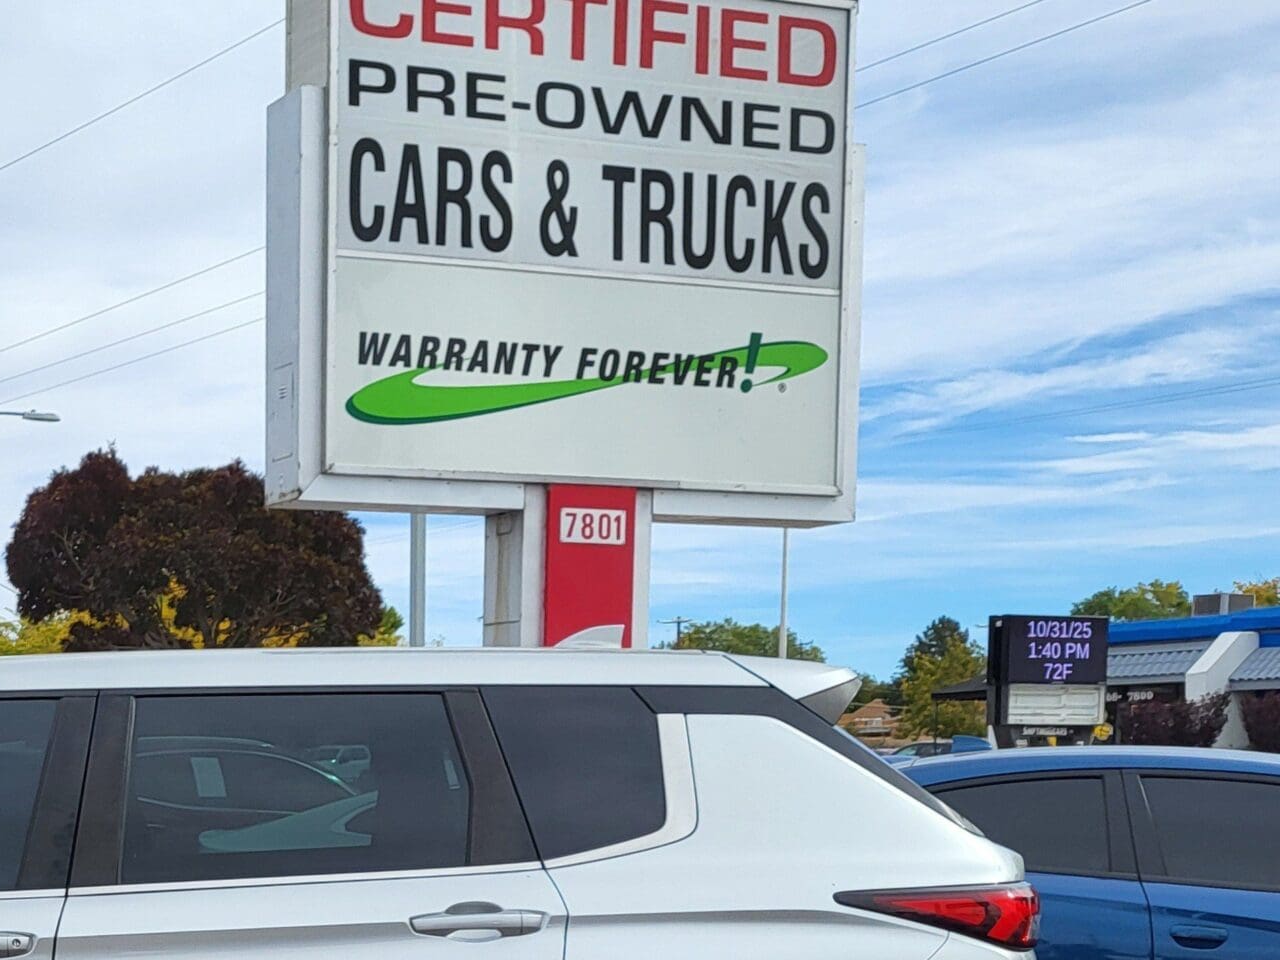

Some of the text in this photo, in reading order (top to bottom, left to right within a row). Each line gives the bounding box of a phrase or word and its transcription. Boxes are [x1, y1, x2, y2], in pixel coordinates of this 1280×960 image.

[348, 0, 838, 88] CERTIFIED
[348, 58, 835, 155] PRE-OWNED
[349, 137, 831, 279] CARS & TRUCKS
[358, 331, 763, 394] WARRANTY FOREVER!
[564, 512, 624, 542] 7801
[1027, 620, 1092, 639] 10/31/25
[1028, 642, 1090, 660] 1:40 PM
[1044, 663, 1073, 680] 72F
